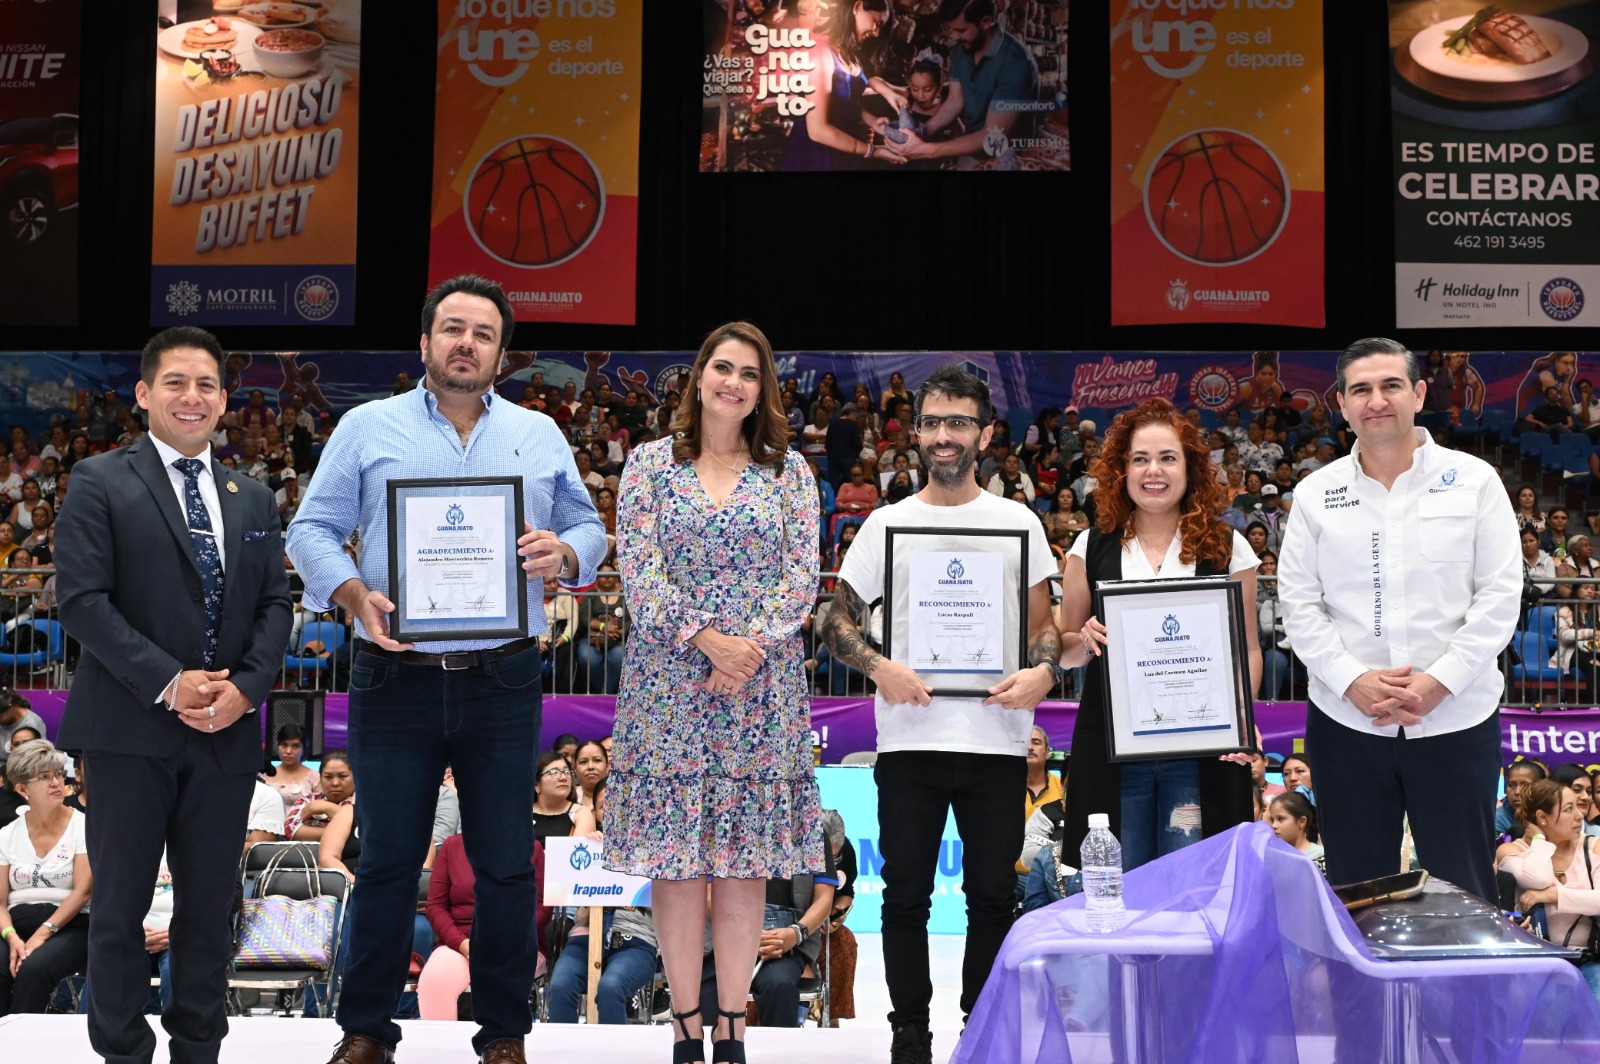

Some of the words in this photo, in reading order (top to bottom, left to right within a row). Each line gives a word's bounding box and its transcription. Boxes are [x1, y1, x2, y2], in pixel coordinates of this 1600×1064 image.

[491, 0, 551, 25] que
[556, 0, 617, 18] nos
[549, 39, 572, 52] es
[575, 35, 593, 52] el
[1131, 20, 1218, 53] une
[1226, 31, 1250, 45] es
[1254, 27, 1272, 45] el
[5, 43, 46, 52] NISSAN
[458, 28, 540, 61] une
[548, 57, 624, 78] deporte
[703, 54, 741, 69] ¿Vas
[744, 57, 755, 69] a
[768, 50, 816, 71] na
[1226, 50, 1306, 70] deporte
[703, 68, 755, 87] viajar?
[756, 66, 816, 101] jua
[702, 84, 724, 97] Que
[725, 86, 745, 94] sea
[746, 86, 754, 94] a
[776, 93, 816, 116] to
[996, 101, 1056, 111] Comonfort
[173, 76, 344, 153] DELICIOSO
[1010, 138, 1068, 148] TURISMO
[1401, 142, 1435, 163] ES
[1441, 142, 1550, 164] TIEMPO
[1557, 143, 1597, 164] DE
[168, 127, 344, 206] DESAYUNO
[1398, 172, 1600, 201] CELEBRAR
[195, 184, 316, 254] BUFFET
[1426, 208, 1573, 228] CONTÁCTANOS
[1453, 235, 1482, 249] 462
[1484, 235, 1505, 249] 191
[1508, 236, 1546, 250] 3495
[206, 288, 277, 303] MOTRIL
[508, 291, 583, 303] GUANAJUATO
[1193, 289, 1271, 302] GUANAJUATO
[1442, 283, 1496, 300] Holiday
[1497, 283, 1521, 298] Inn
[1442, 301, 1454, 309] UN
[1456, 301, 1482, 309] HOTEL
[1325, 485, 1348, 496] Estoy
[1324, 495, 1346, 504] para
[1324, 499, 1361, 510] servirte
[416, 547, 488, 555] AGRADECIMIENTO
[1371, 531, 1380, 560] GENTE
[1372, 562, 1380, 575] LA
[1373, 576, 1381, 589] DE
[918, 600, 986, 608] RECONOCIMIENTO
[1374, 591, 1382, 637] GOBIERNO
[1154, 634, 1191, 643] GUANAJUATO
[1136, 656, 1206, 667] RECONOCIMIENTO
[1187, 667, 1209, 675] Aguilar
[571, 883, 624, 898] Irapuato
